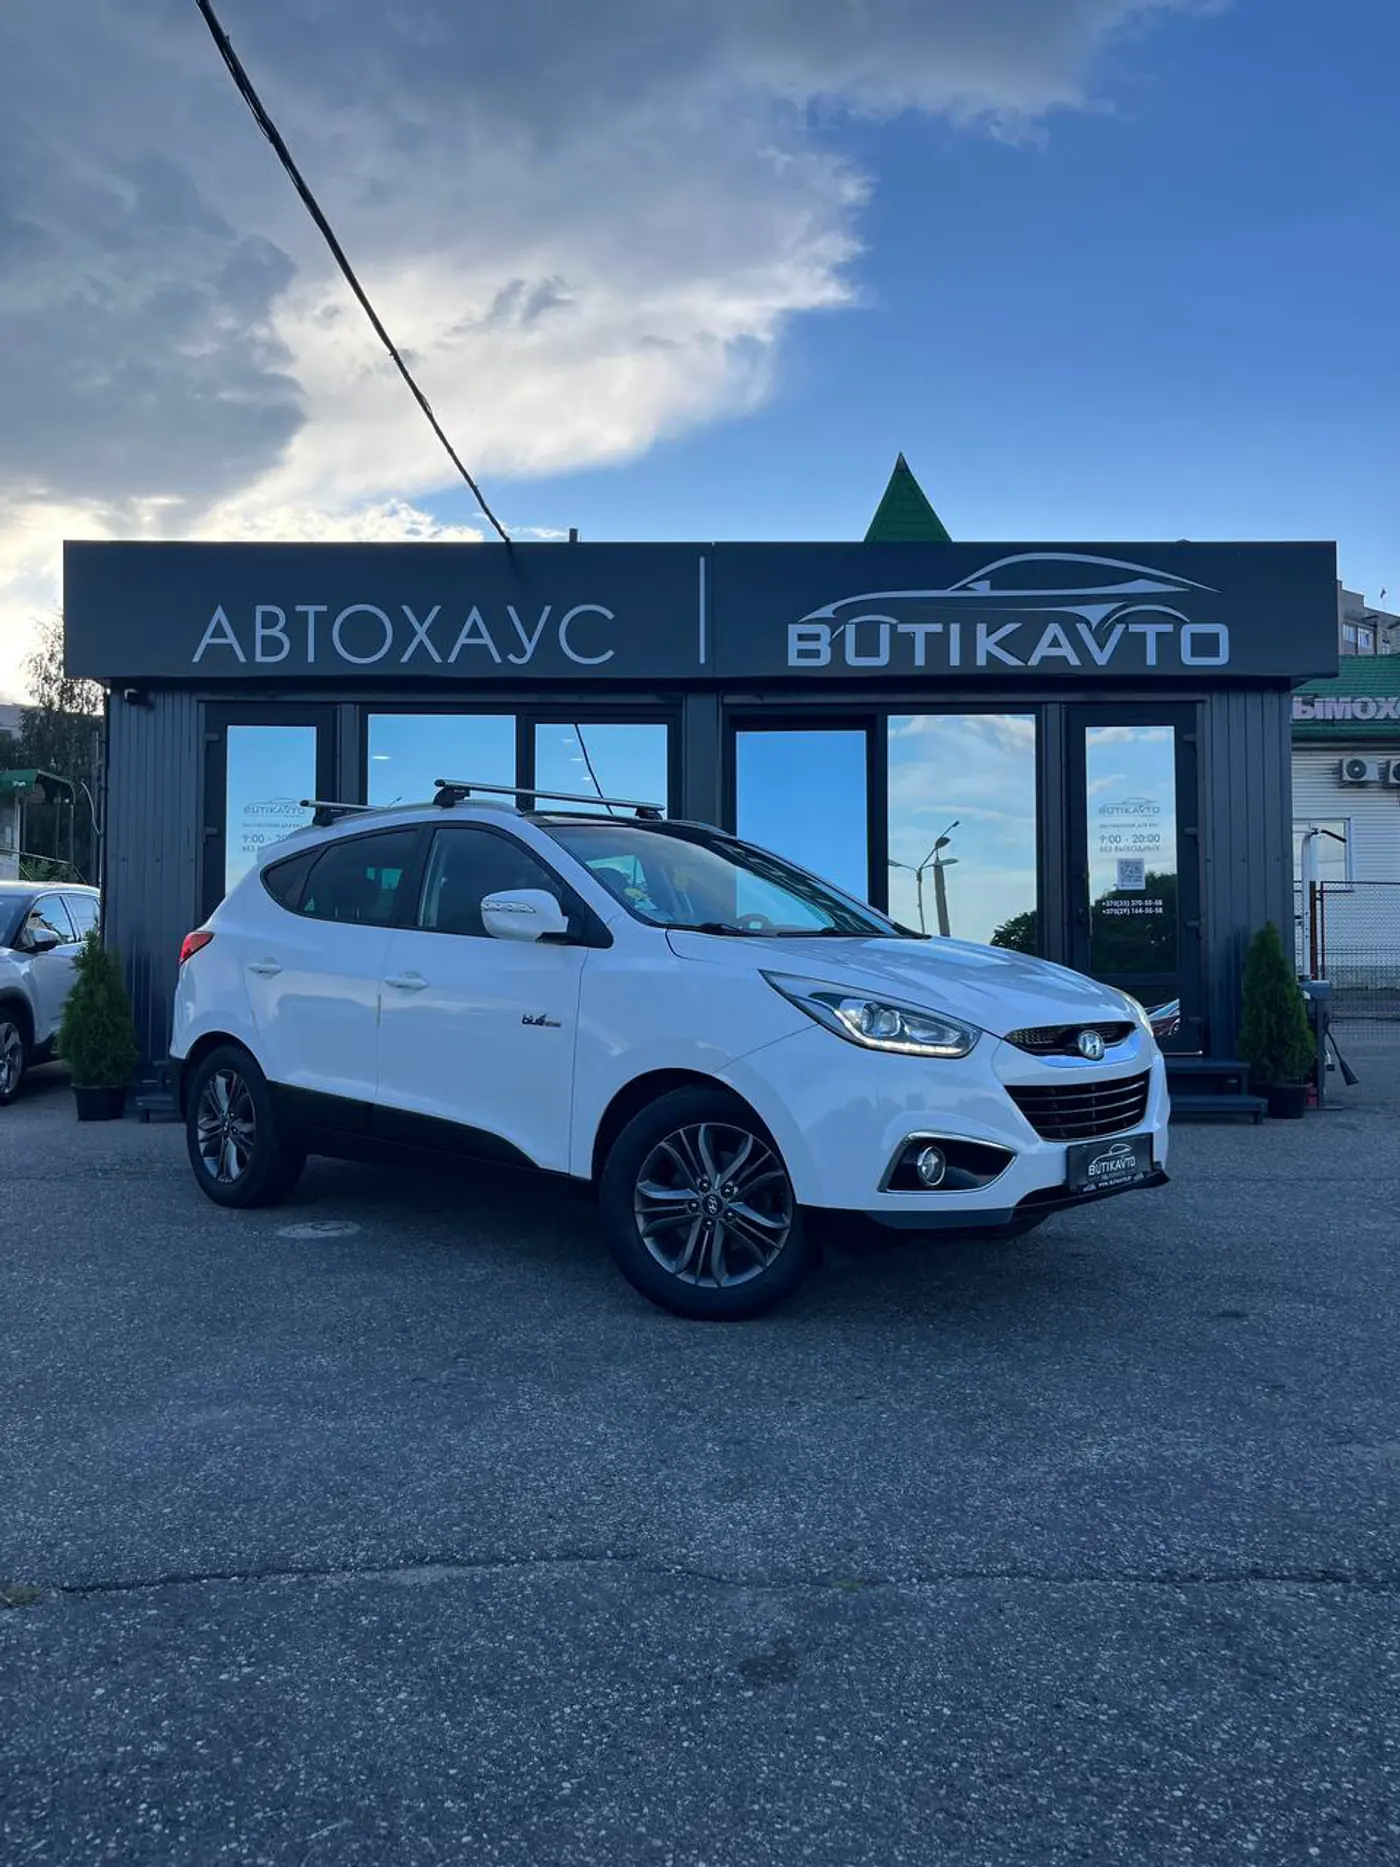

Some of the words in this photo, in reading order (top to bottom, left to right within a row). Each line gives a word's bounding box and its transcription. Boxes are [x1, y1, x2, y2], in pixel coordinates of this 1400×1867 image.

[192, 603, 616, 665] АВТОХАУС
[787, 622, 1230, 666] BUTIKAVTO
[1290, 696, 1400, 721] ЫМОХ
[1098, 806, 1160, 815] BUTIKAVTO
[1099, 834, 1122, 844] 9:00
[1131, 834, 1161, 843] 20:00
[1088, 1156, 1136, 1177] BUTIKAVTO
